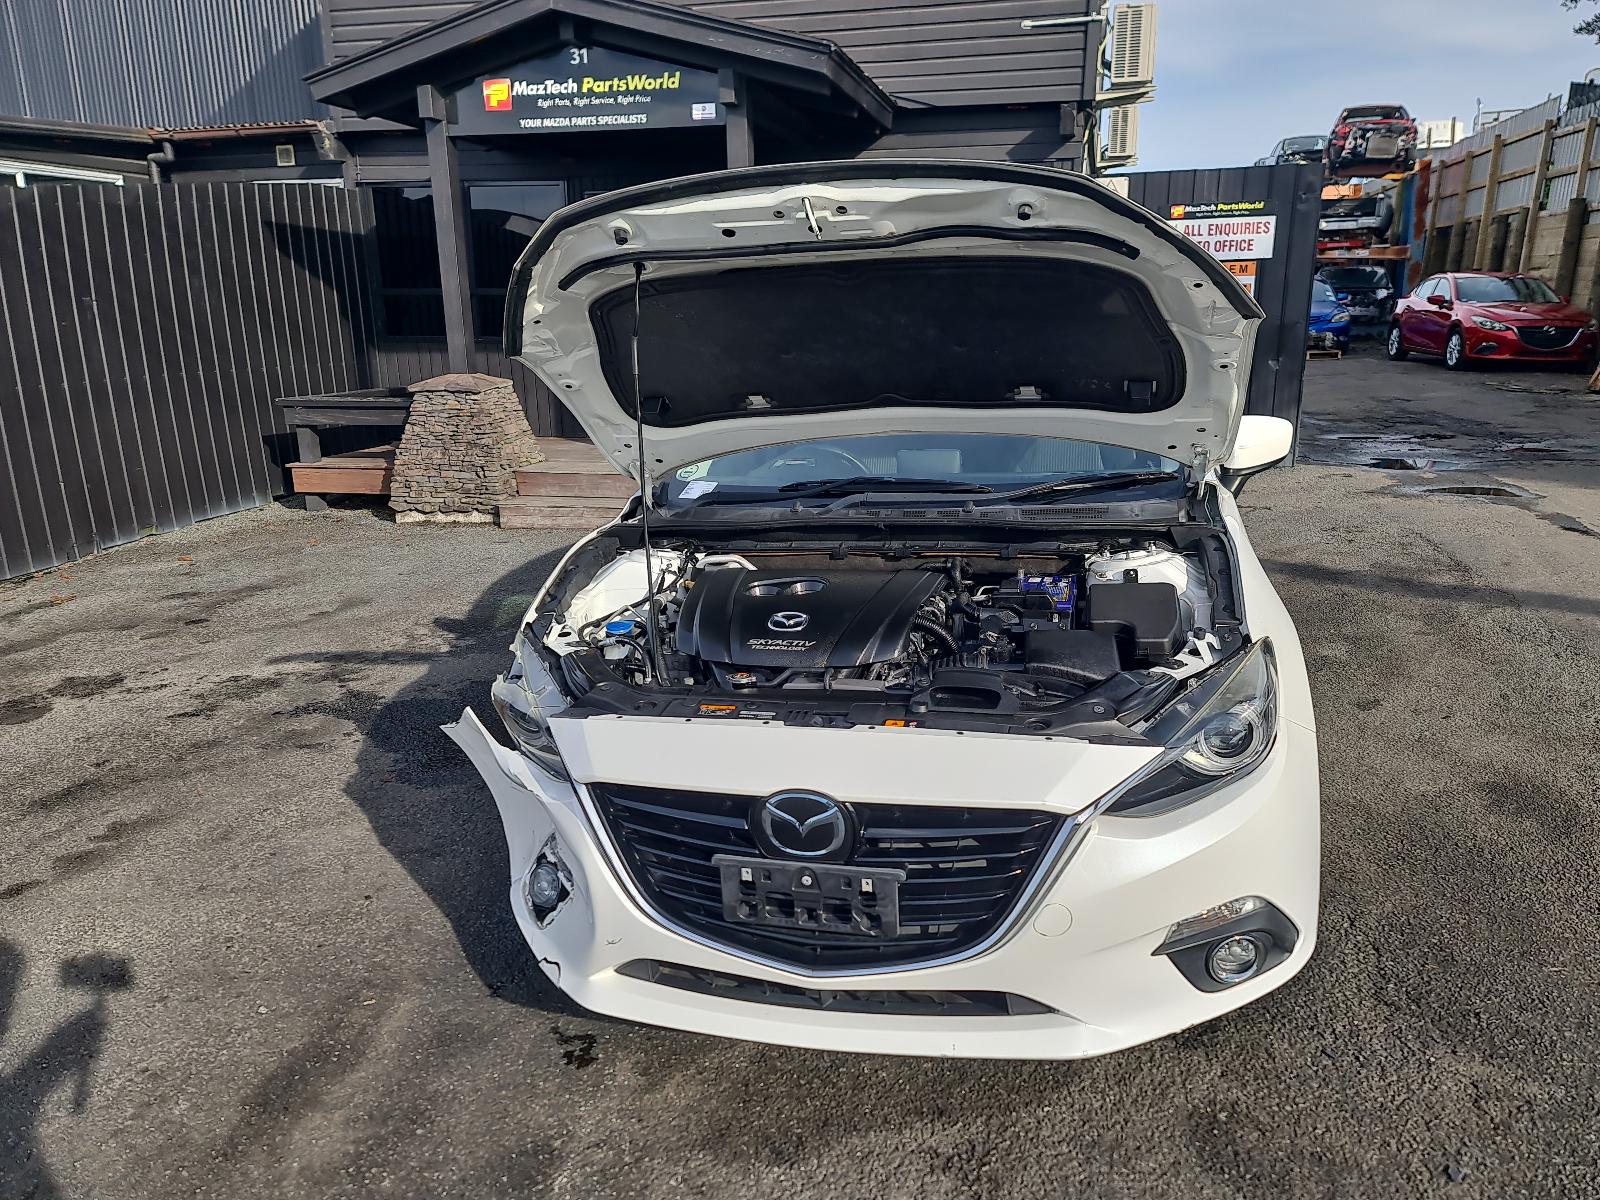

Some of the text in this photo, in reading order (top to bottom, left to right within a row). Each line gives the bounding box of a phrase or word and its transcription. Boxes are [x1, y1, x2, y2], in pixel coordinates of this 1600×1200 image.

[569, 47, 588, 65] 31
[511, 71, 681, 96] MazTech PartsWorld
[537, 98, 554, 109] Right
[573, 96, 590, 107] Right
[617, 94, 634, 106] Right
[519, 113, 648, 128] YOUR MAZDA PARTS SPECIALISTS
[1217, 201, 1264, 211] PartsWorld
[1183, 221, 1271, 237] ALL ENQUIRIES
[1213, 239, 1255, 253] OFFICE
